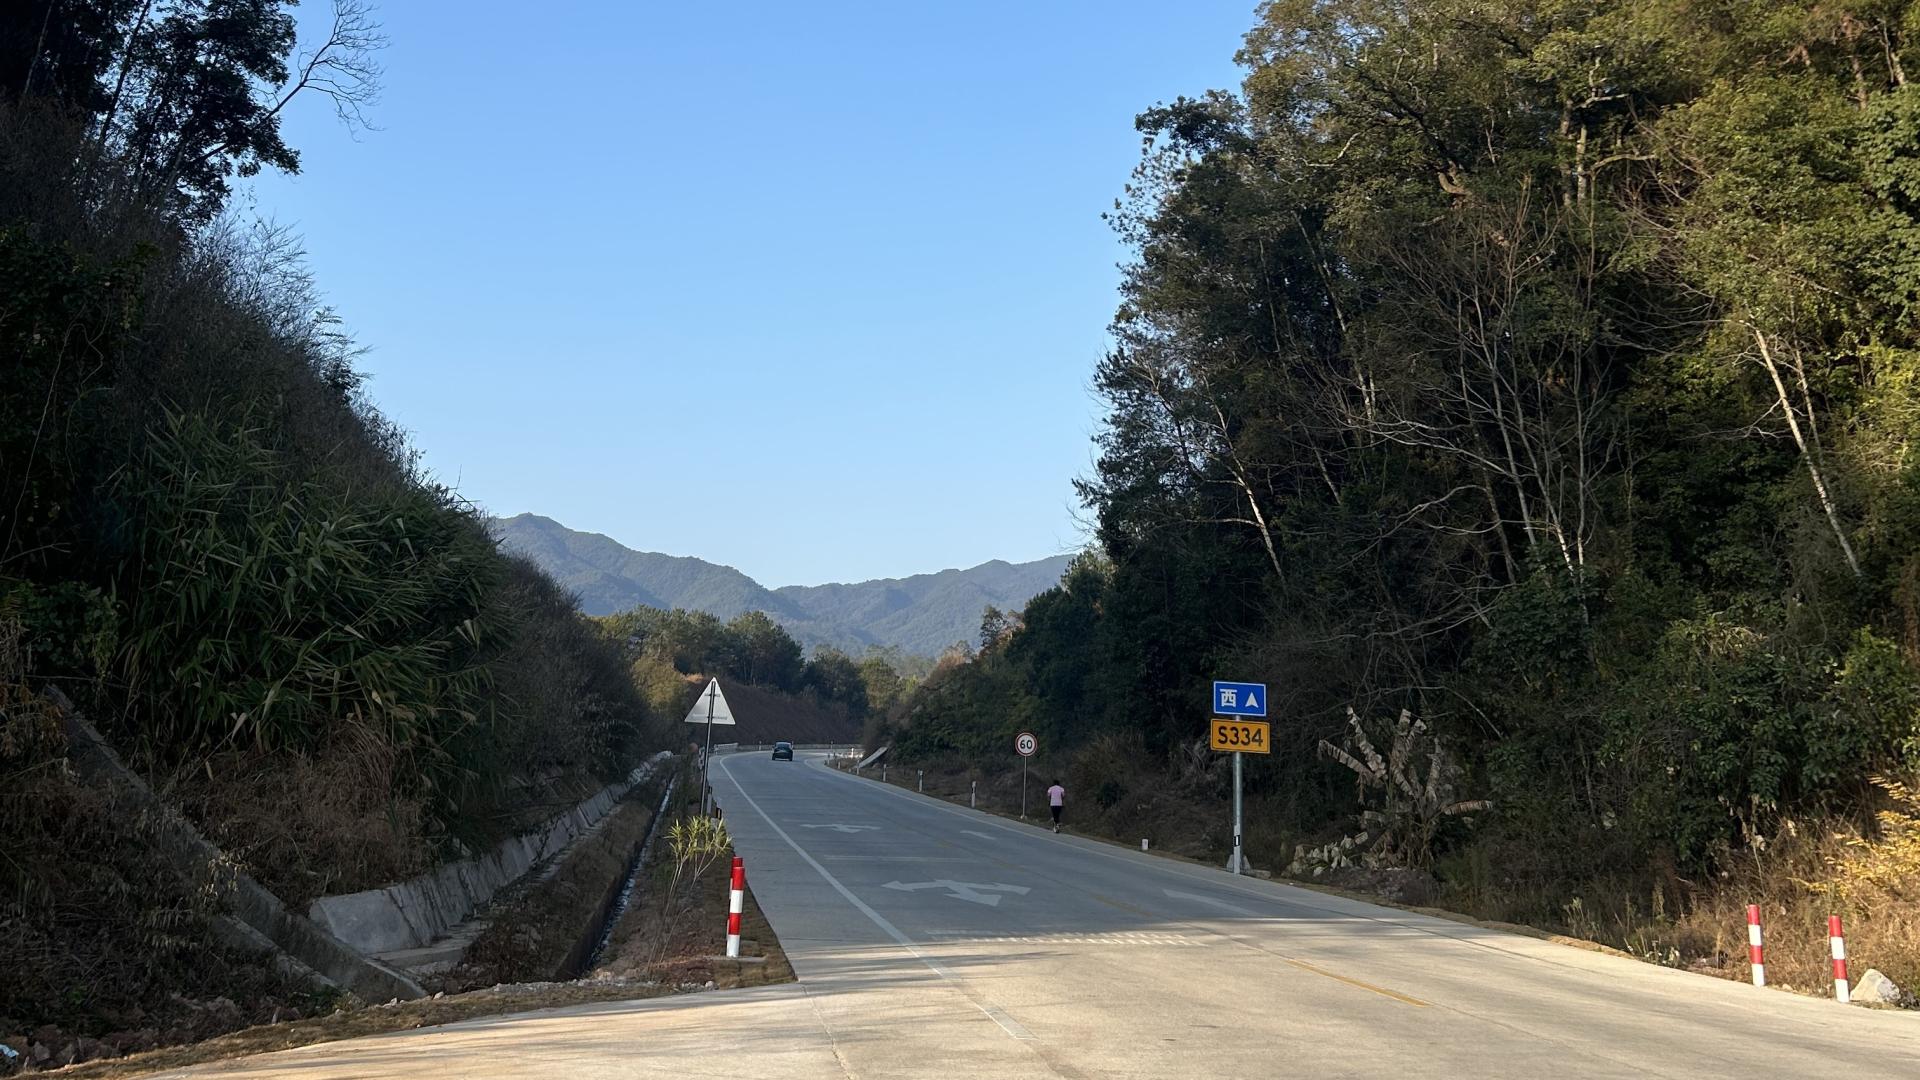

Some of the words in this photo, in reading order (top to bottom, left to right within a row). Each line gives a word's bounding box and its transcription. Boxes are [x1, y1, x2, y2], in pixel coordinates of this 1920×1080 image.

[1219, 688, 1238, 708] 西
[1020, 740, 1033, 749] 60
[1217, 726, 1263, 747] S334
